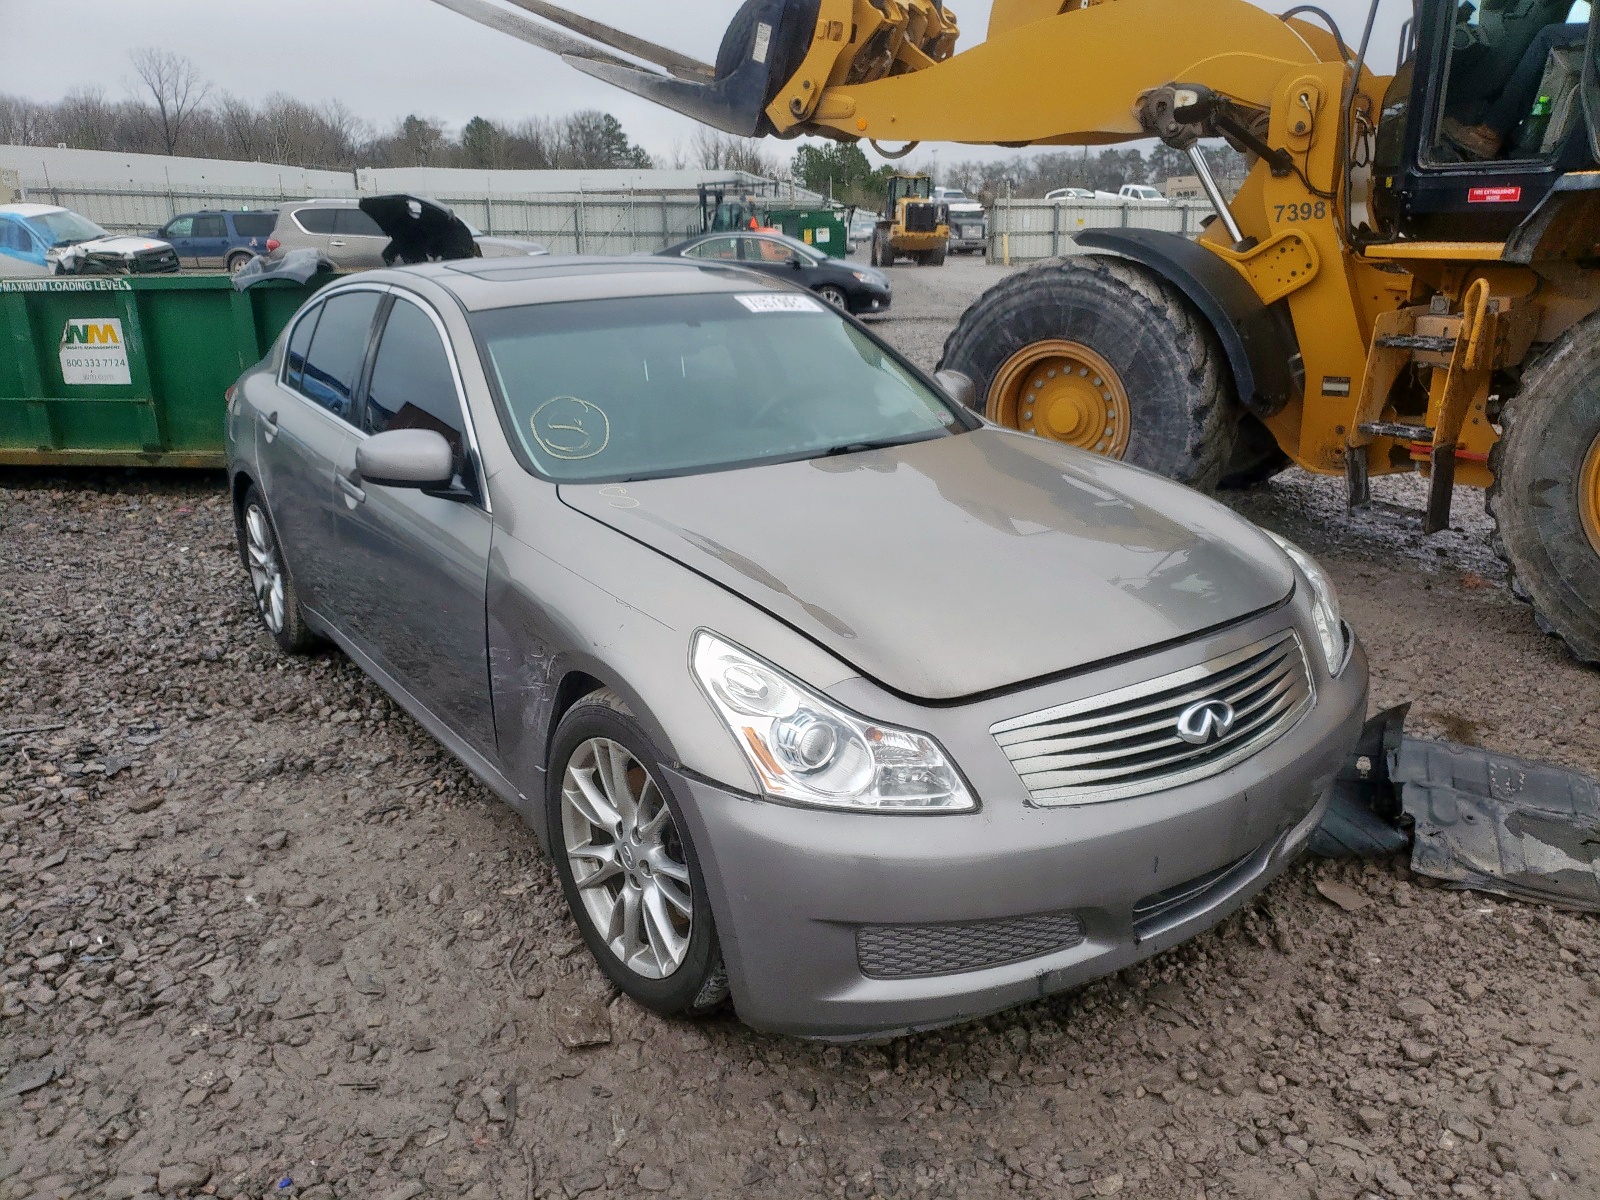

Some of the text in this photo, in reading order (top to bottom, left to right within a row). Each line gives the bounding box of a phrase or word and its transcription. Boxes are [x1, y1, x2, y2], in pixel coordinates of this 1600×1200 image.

[1273, 201, 1326, 223] 7398
[2, 280, 125, 292] MAXIMUM LOADING LEVEL
[66, 358, 126, 367] 800 333 7724
